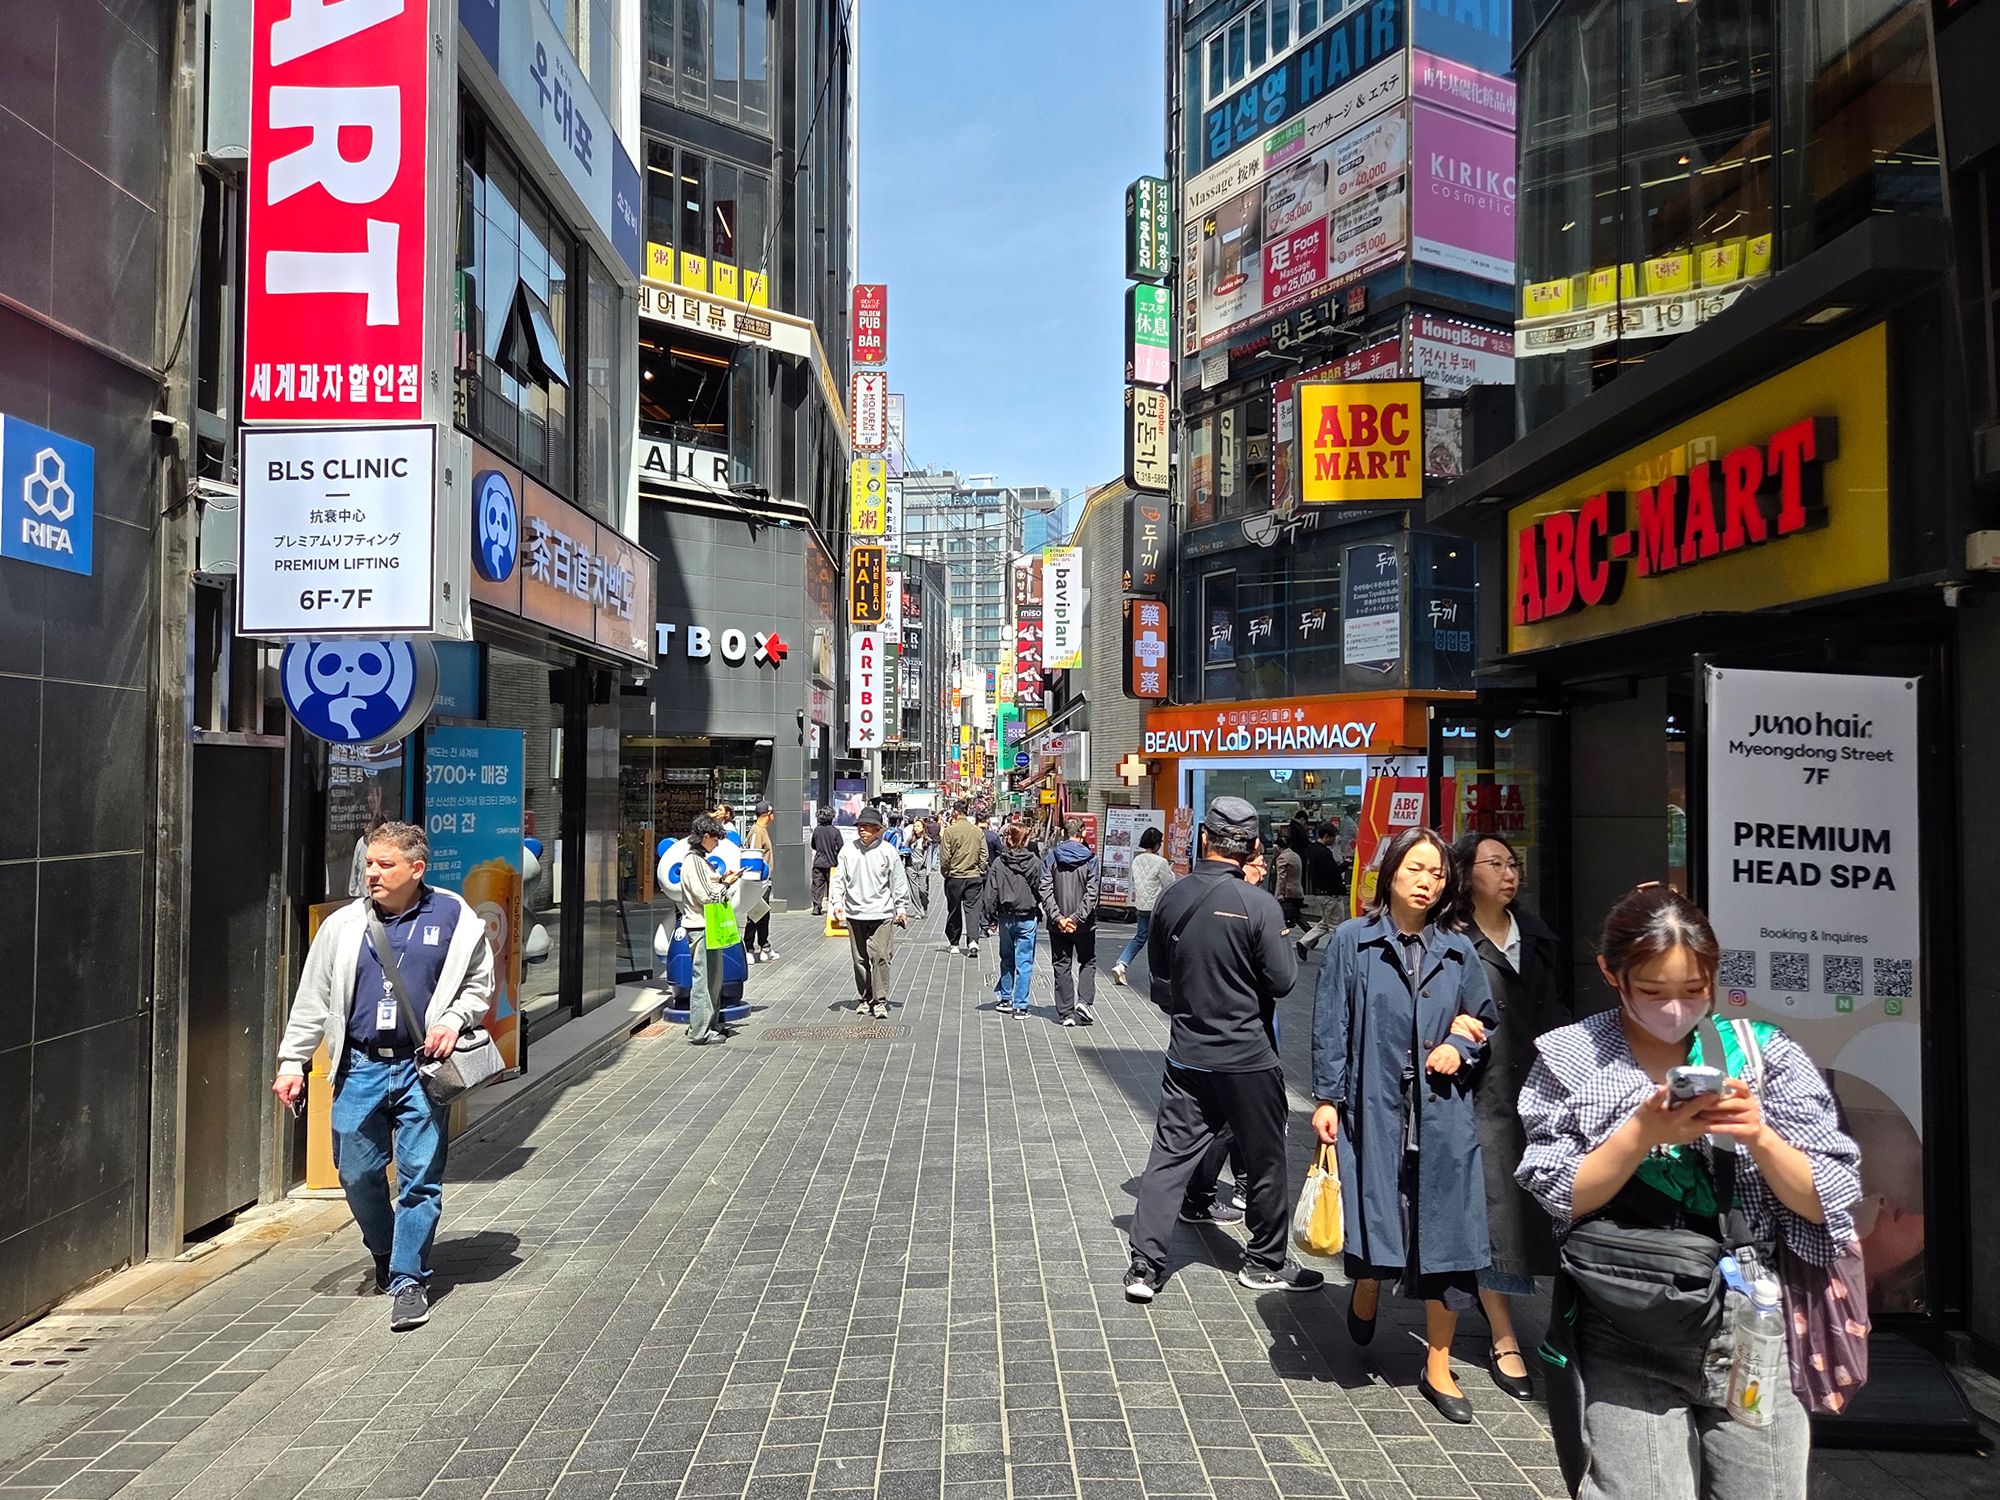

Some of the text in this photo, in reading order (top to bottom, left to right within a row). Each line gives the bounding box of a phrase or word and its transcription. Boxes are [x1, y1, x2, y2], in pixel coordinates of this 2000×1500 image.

[1208, 0, 1395, 158] 김선영 HAIR
[530, 40, 593, 177] 우대포
[1307, 99, 1352, 137] マッサージ
[1368, 73, 1400, 103] エステ
[1188, 175, 1233, 210] Massage
[1432, 183, 1515, 216] cosmetic
[1139, 180, 1150, 268] HAIR SALON
[1157, 185, 1169, 274] 김선영 미용실
[1270, 239, 1290, 274] 足
[1293, 231, 1320, 255] Foot
[1279, 260, 1311, 279] Massage
[859, 316, 880, 329] PUB
[1140, 302, 1165, 315] エステ
[1136, 312, 1168, 337] 休息
[1422, 319, 1487, 348] HongBar
[858, 335, 880, 347] BAR
[1320, 366, 1342, 380] BAR
[1370, 352, 1380, 366] 3F
[1420, 347, 1476, 372] 점심부페
[250, 363, 419, 403] 세계과자할인점
[1158, 395, 1166, 435] Hongbar
[1314, 403, 1410, 448] ABC
[268, 458, 408, 481] BLS CLINIC
[1315, 450, 1410, 481] MART
[310, 509, 366, 523] 抗衰中心
[1514, 416, 1816, 625] ABC-MART
[22, 518, 74, 554] RIFA
[274, 532, 400, 548] プレミアムリフティング
[1141, 524, 1159, 569] 두끼
[275, 557, 399, 571] PREMIUM LIFTING
[856, 552, 870, 617] HAIR
[1143, 573, 1156, 585] 2F
[1020, 609, 1041, 617] miso
[1055, 568, 1070, 647] baviplan
[1427, 600, 1457, 629] 두끼
[1209, 625, 1232, 650] 두끼
[1248, 618, 1272, 645] 두끼
[1299, 612, 1326, 639] 두끼
[860, 637, 875, 741] ARTBOX
[884, 655, 894, 725] ANOTHER
[1145, 722, 1376, 753] BEAUTY Lab PHARMACY
[1729, 740, 1894, 763] Myeongdong Street
[481, 765, 509, 785] 매장
[1803, 767, 1829, 785] 7F
[1393, 811, 1417, 820] MART
[1394, 798, 1419, 811] ABC
[461, 812, 475, 833] 잔
[1733, 822, 1891, 855] PREMIUM
[1733, 859, 1895, 891] HEAD SPA
[1760, 928, 1868, 944] Booking & Inquires
